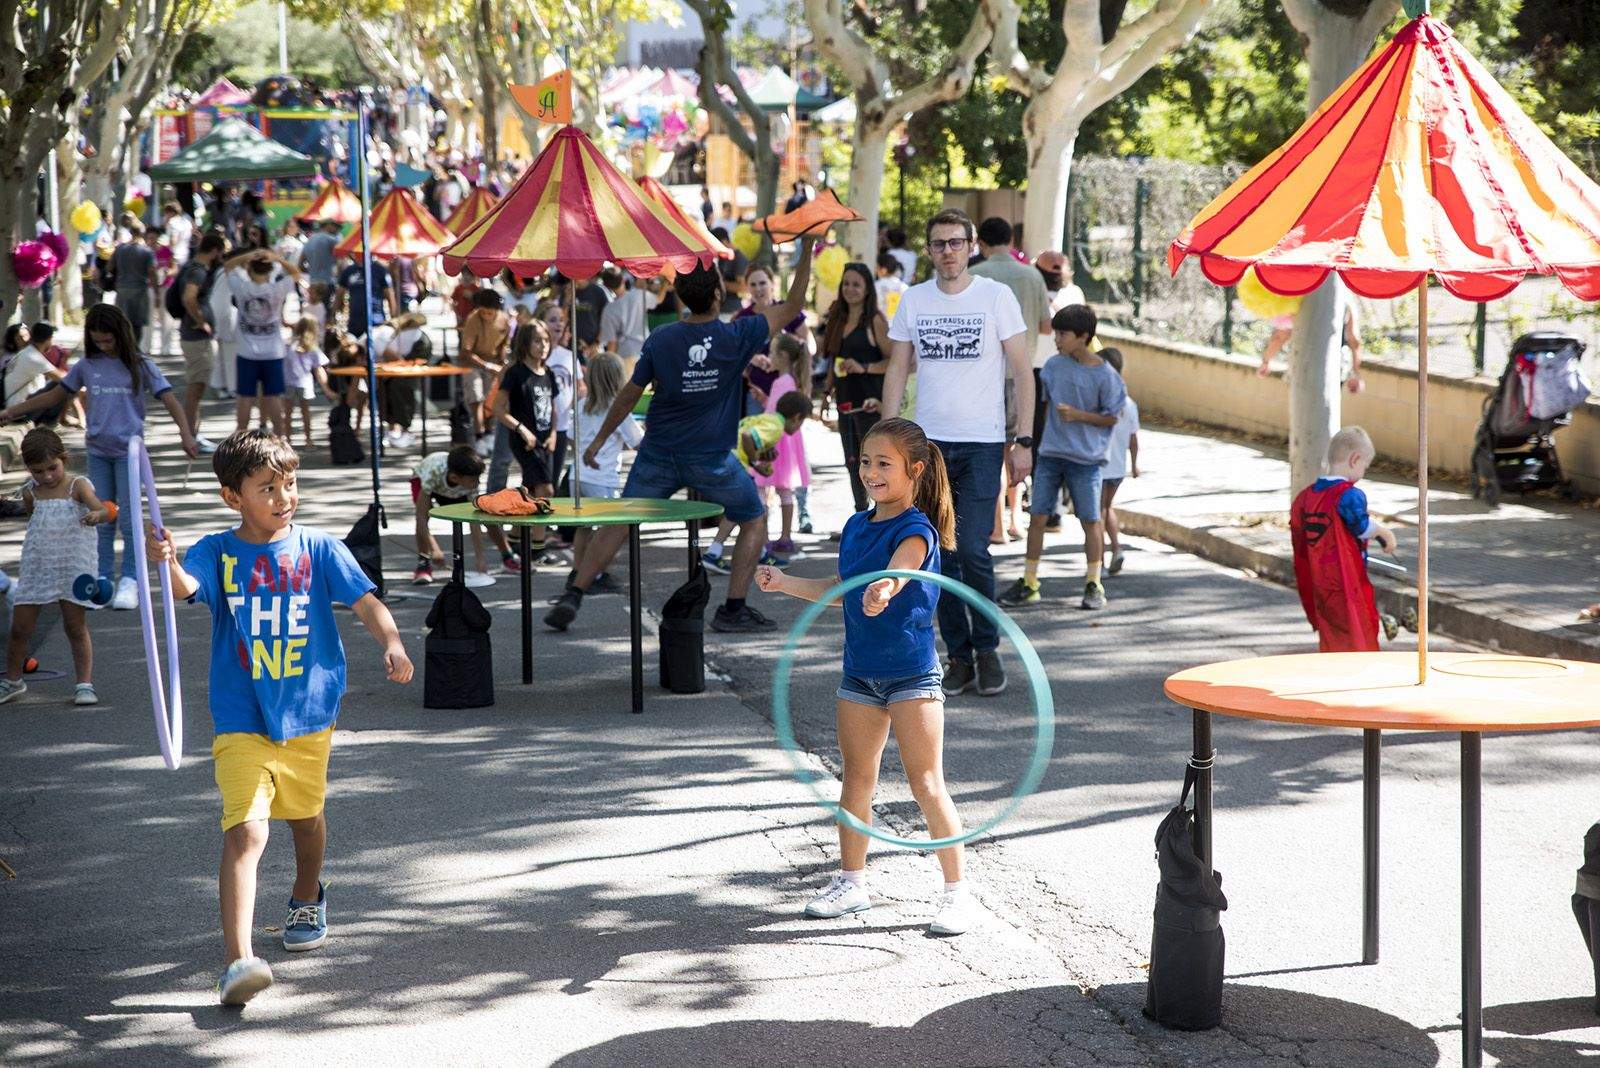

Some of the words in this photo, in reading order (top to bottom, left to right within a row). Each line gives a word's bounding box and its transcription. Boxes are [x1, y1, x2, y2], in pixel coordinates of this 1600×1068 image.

[934, 317, 965, 326] STRAUSS
[247, 554, 312, 593] AM
[237, 638, 308, 680] NE
